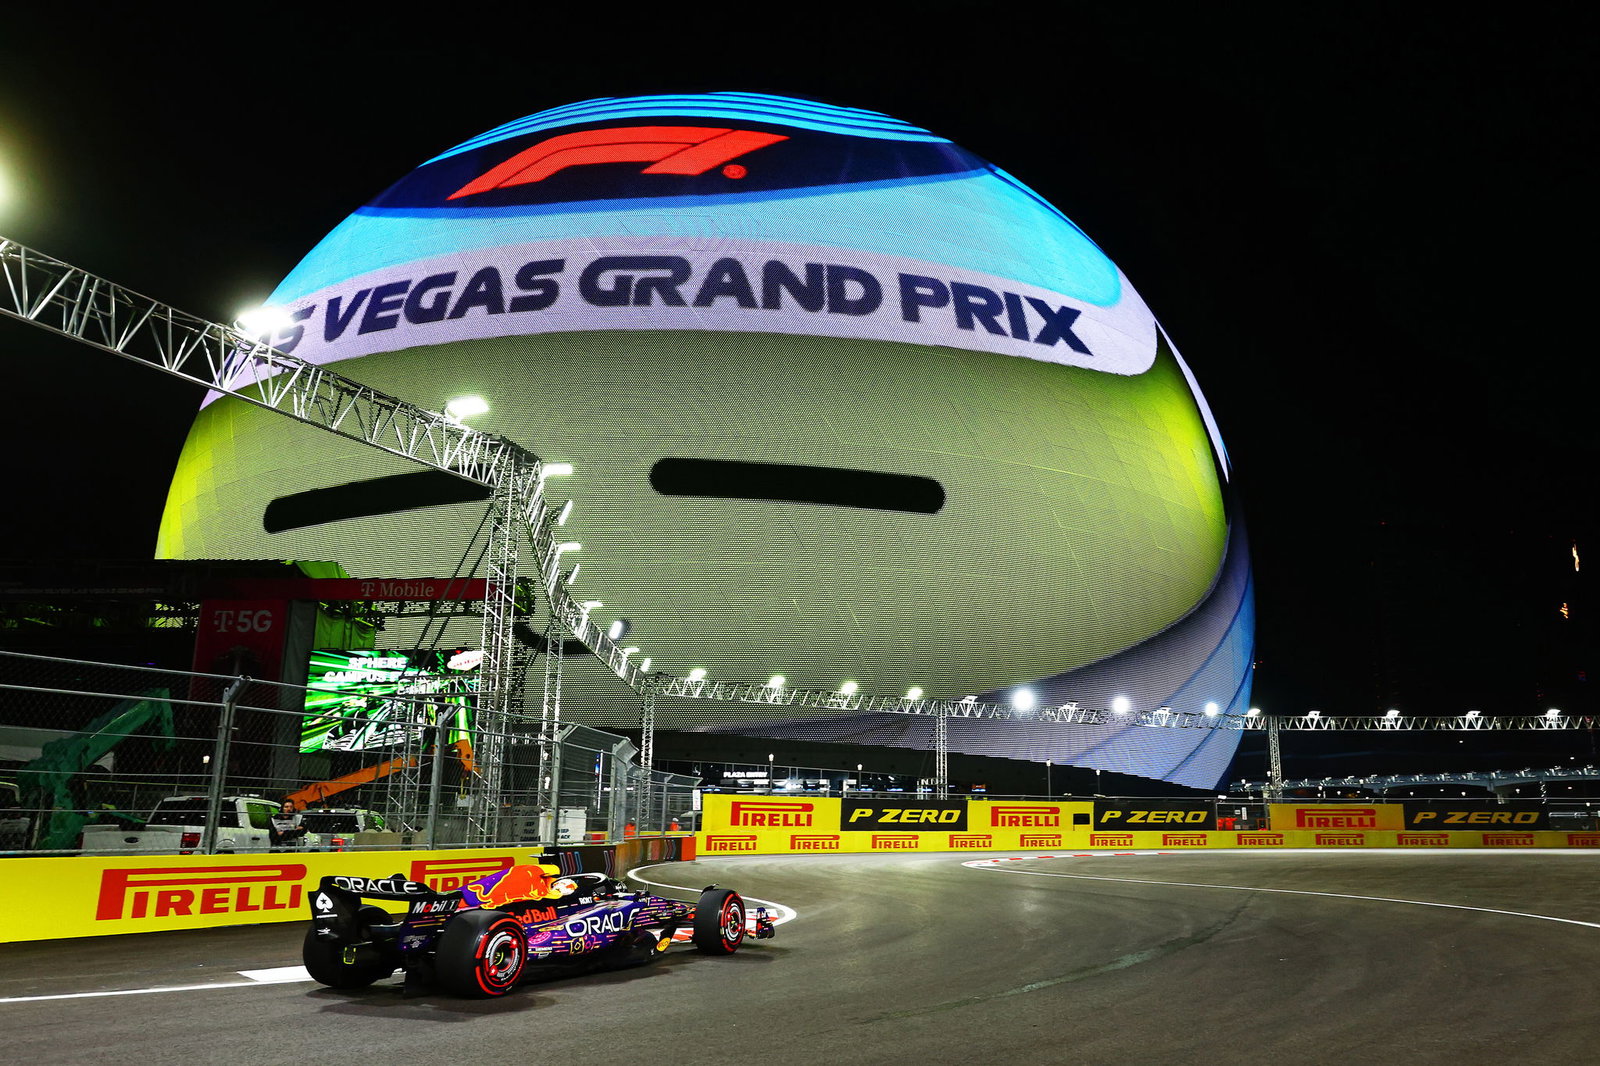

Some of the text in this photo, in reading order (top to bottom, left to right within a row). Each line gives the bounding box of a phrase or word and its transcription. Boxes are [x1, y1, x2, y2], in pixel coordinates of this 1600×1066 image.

[323, 258, 565, 342] VEGAS
[577, 255, 884, 317] GRAND
[897, 272, 1094, 356] PRIX
[379, 582, 435, 597] Mobile
[349, 657, 407, 669] SPHERE
[731, 801, 814, 826] PIRELLI
[849, 809, 961, 824] P ZERO
[991, 806, 1060, 827] PIRELLI
[1100, 811, 1208, 824] P ZERO
[1296, 809, 1376, 828] PIRELLI
[1413, 812, 1540, 824] P ZERO
[706, 835, 757, 851] PIRELLI
[790, 835, 840, 850] PIRELLI
[872, 835, 919, 849] PIRELLI
[950, 834, 992, 848] PIRELLI
[1020, 834, 1062, 847] PIRELLI
[1090, 834, 1133, 846] PIRELLI
[1163, 834, 1207, 846] PIRELLI
[1237, 834, 1284, 845] PIRELLI
[1315, 834, 1364, 845] PIRELLI
[1397, 834, 1449, 846] PIRELLI
[1483, 834, 1534, 846] PIRELLI
[96, 864, 307, 920] PIRELLI
[334, 876, 419, 894] ORACLE
[412, 900, 446, 914] Mobil
[531, 906, 557, 922] Bull
